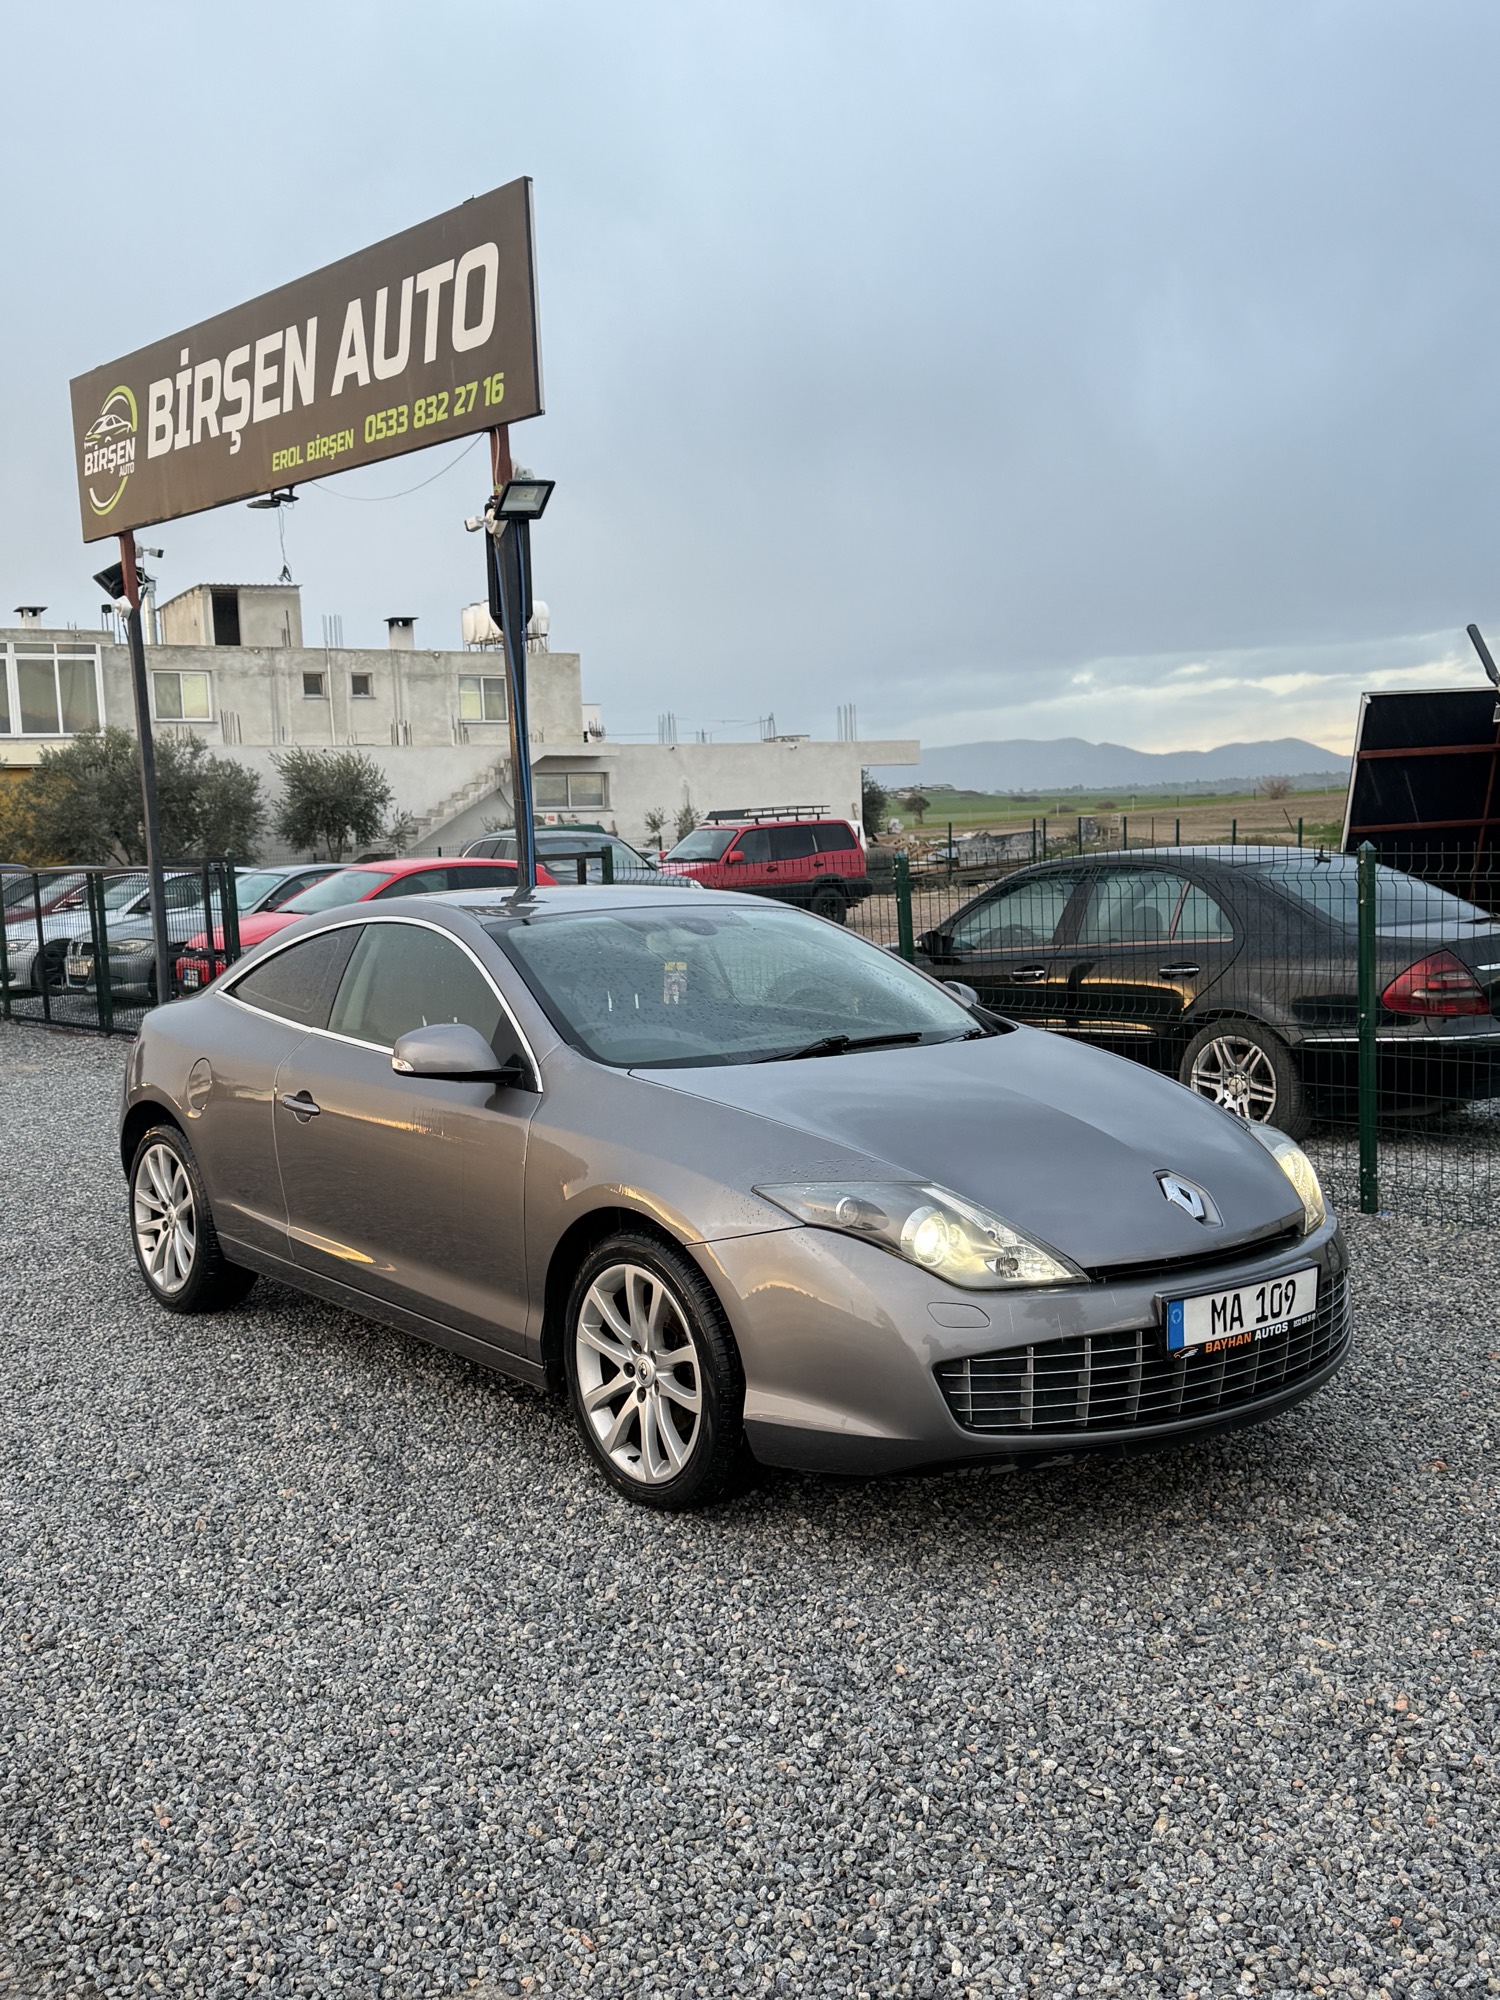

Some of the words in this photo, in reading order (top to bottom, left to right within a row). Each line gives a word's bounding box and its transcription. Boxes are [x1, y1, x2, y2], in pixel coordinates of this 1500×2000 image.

[147, 316, 317, 459] BİRŞEN
[330, 241, 499, 397] AUTO
[272, 445, 304, 472] EROL
[307, 428, 354, 460] BİRŞEN
[364, 404, 408, 444] 0533
[413, 391, 449, 429] 832
[453, 381, 478, 417] 27
[483, 372, 504, 407] 16
[84, 437, 136, 476] BİRŞEN
[118, 461, 135, 477] AUTO
[1211, 1293, 1244, 1335] MA
[1255, 1279, 1296, 1324] 109
[1205, 1332, 1252, 1353] BAYHAN
[1254, 1321, 1289, 1341] AUTOS
